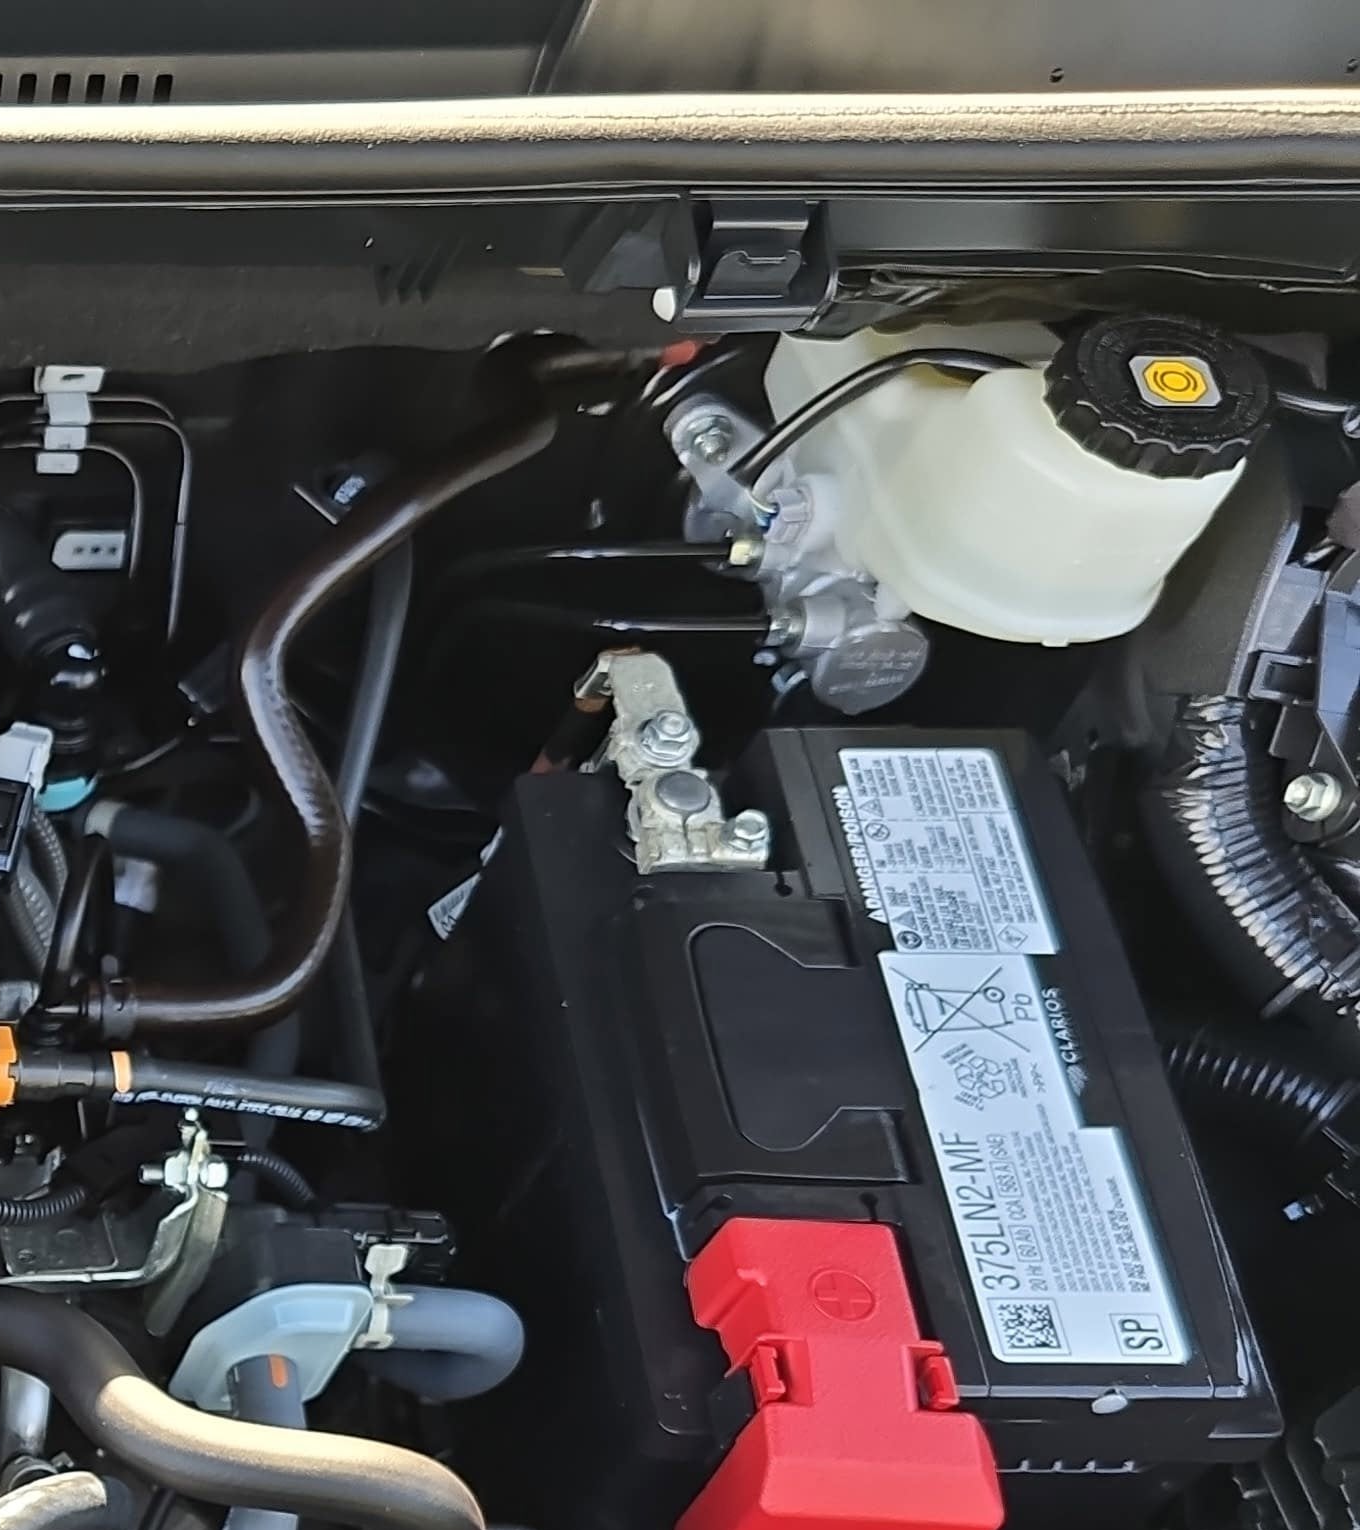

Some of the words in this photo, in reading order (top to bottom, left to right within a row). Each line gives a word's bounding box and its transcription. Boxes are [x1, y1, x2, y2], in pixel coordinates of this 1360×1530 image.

[1013, 992, 1040, 1023] Pb
[1042, 987, 1080, 1064] CLARIOS
[939, 1132, 1021, 1292] 375LN2-MF
[1017, 1243, 1038, 1258] 60
[1028, 1278, 1049, 1292] 20
[1118, 1317, 1165, 1351] SP
